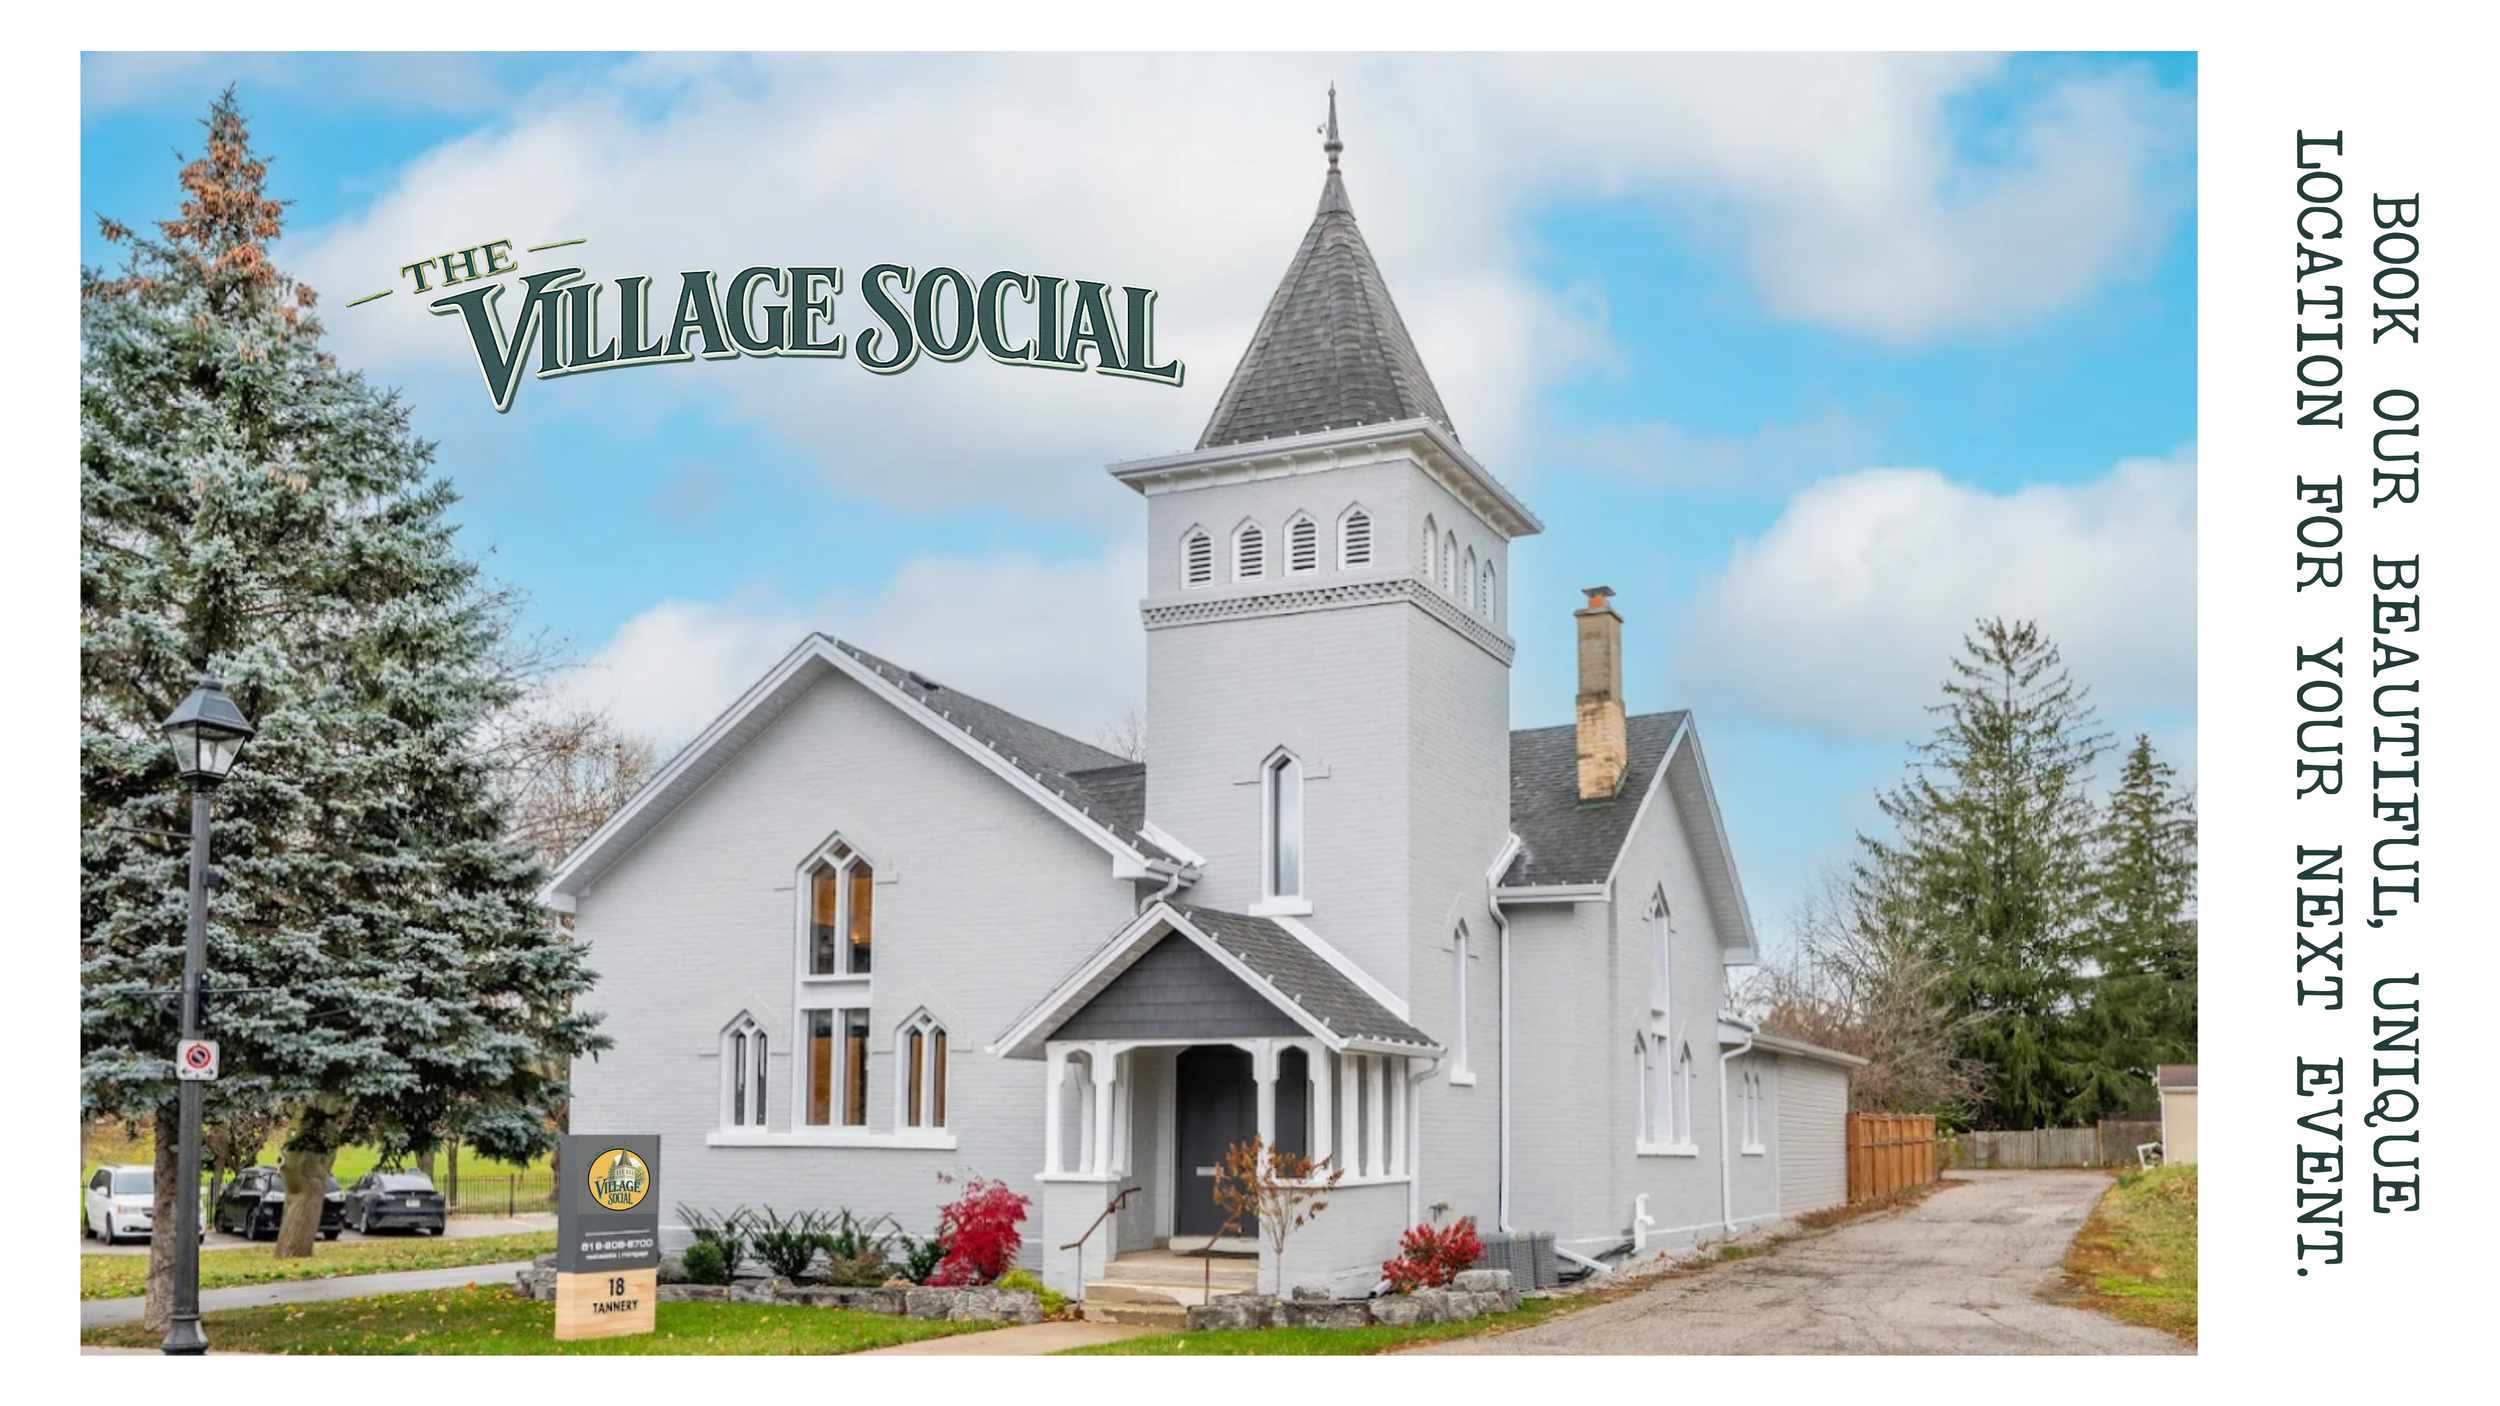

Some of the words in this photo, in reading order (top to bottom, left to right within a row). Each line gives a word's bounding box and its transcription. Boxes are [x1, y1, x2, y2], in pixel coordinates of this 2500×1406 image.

[593, 1177, 642, 1201] VILLAGE
[607, 1192, 634, 1206] SOCIAL
[609, 1277, 625, 1297] 18
[592, 1299, 639, 1314] TANNERY
